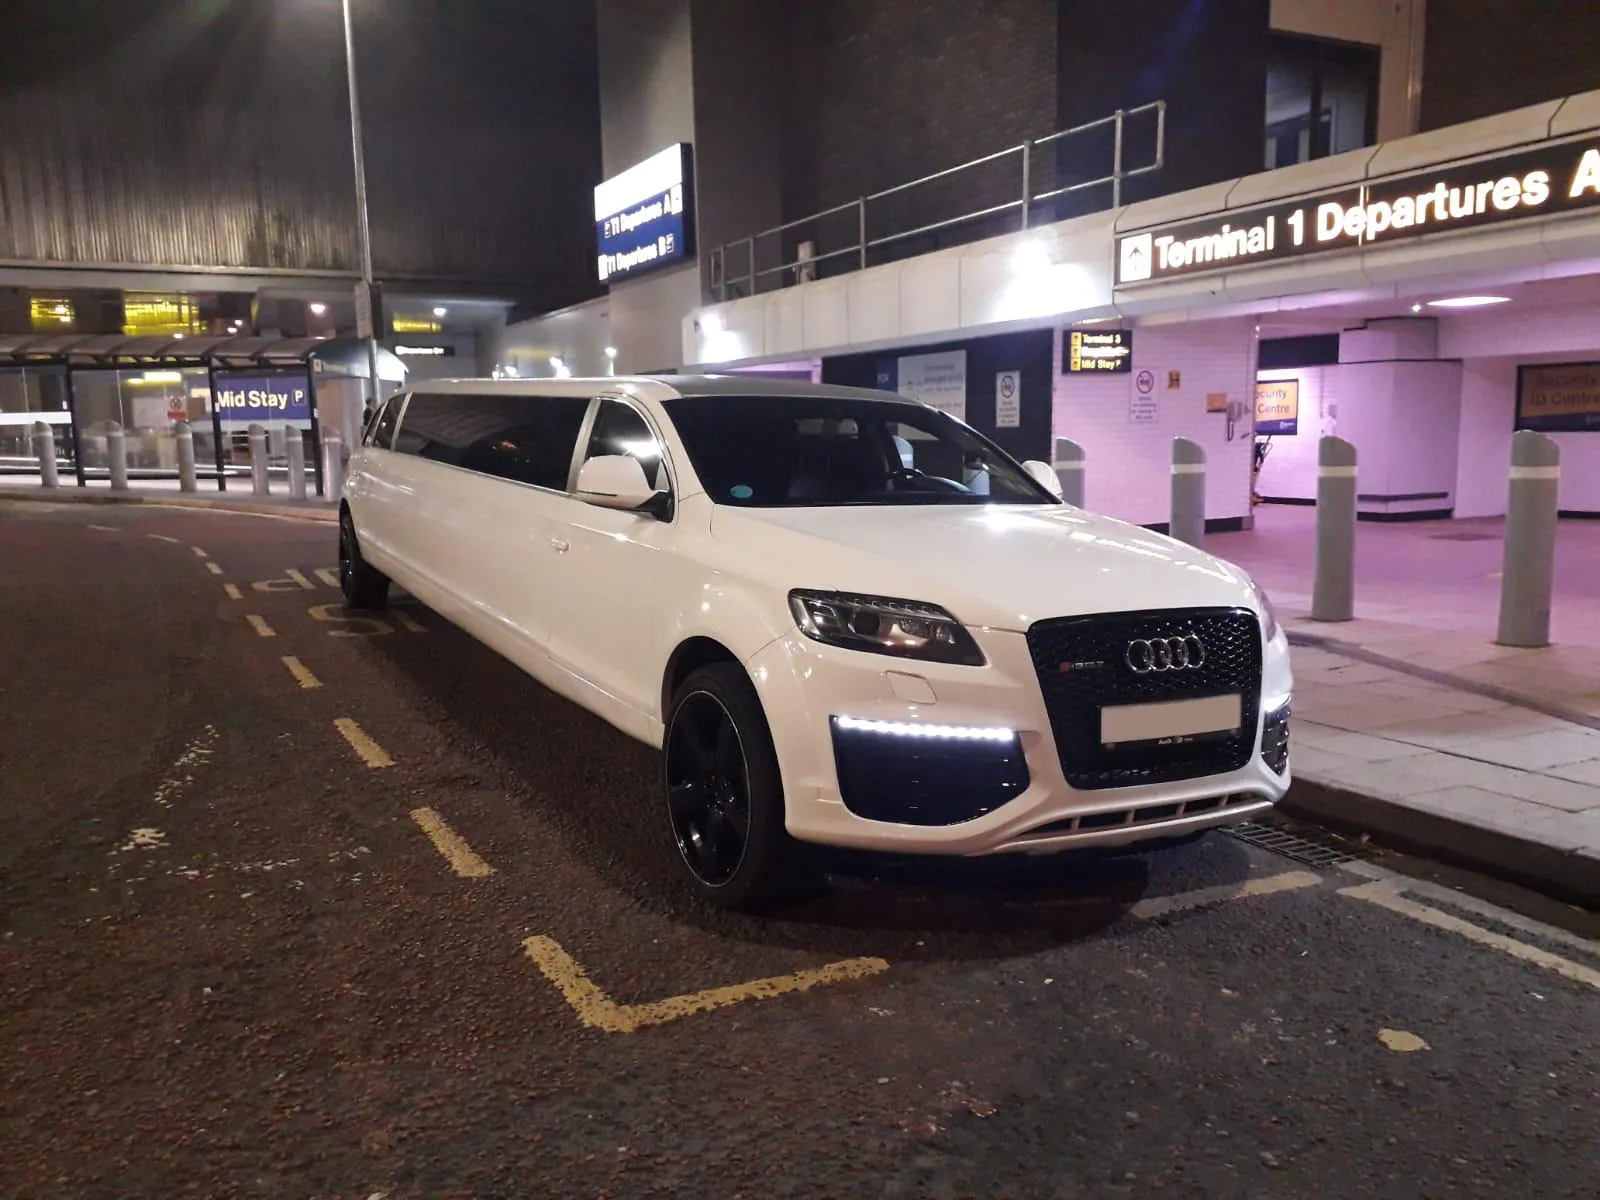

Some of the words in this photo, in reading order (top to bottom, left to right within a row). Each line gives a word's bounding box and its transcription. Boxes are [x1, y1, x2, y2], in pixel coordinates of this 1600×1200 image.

[1155, 215, 1275, 269] Terminal
[1287, 208, 1304, 246] 1
[1317, 169, 1550, 241] Departures
[217, 390, 245, 408] Mid
[249, 390, 288, 410] Stay
[1257, 403, 1290, 414] Centre
